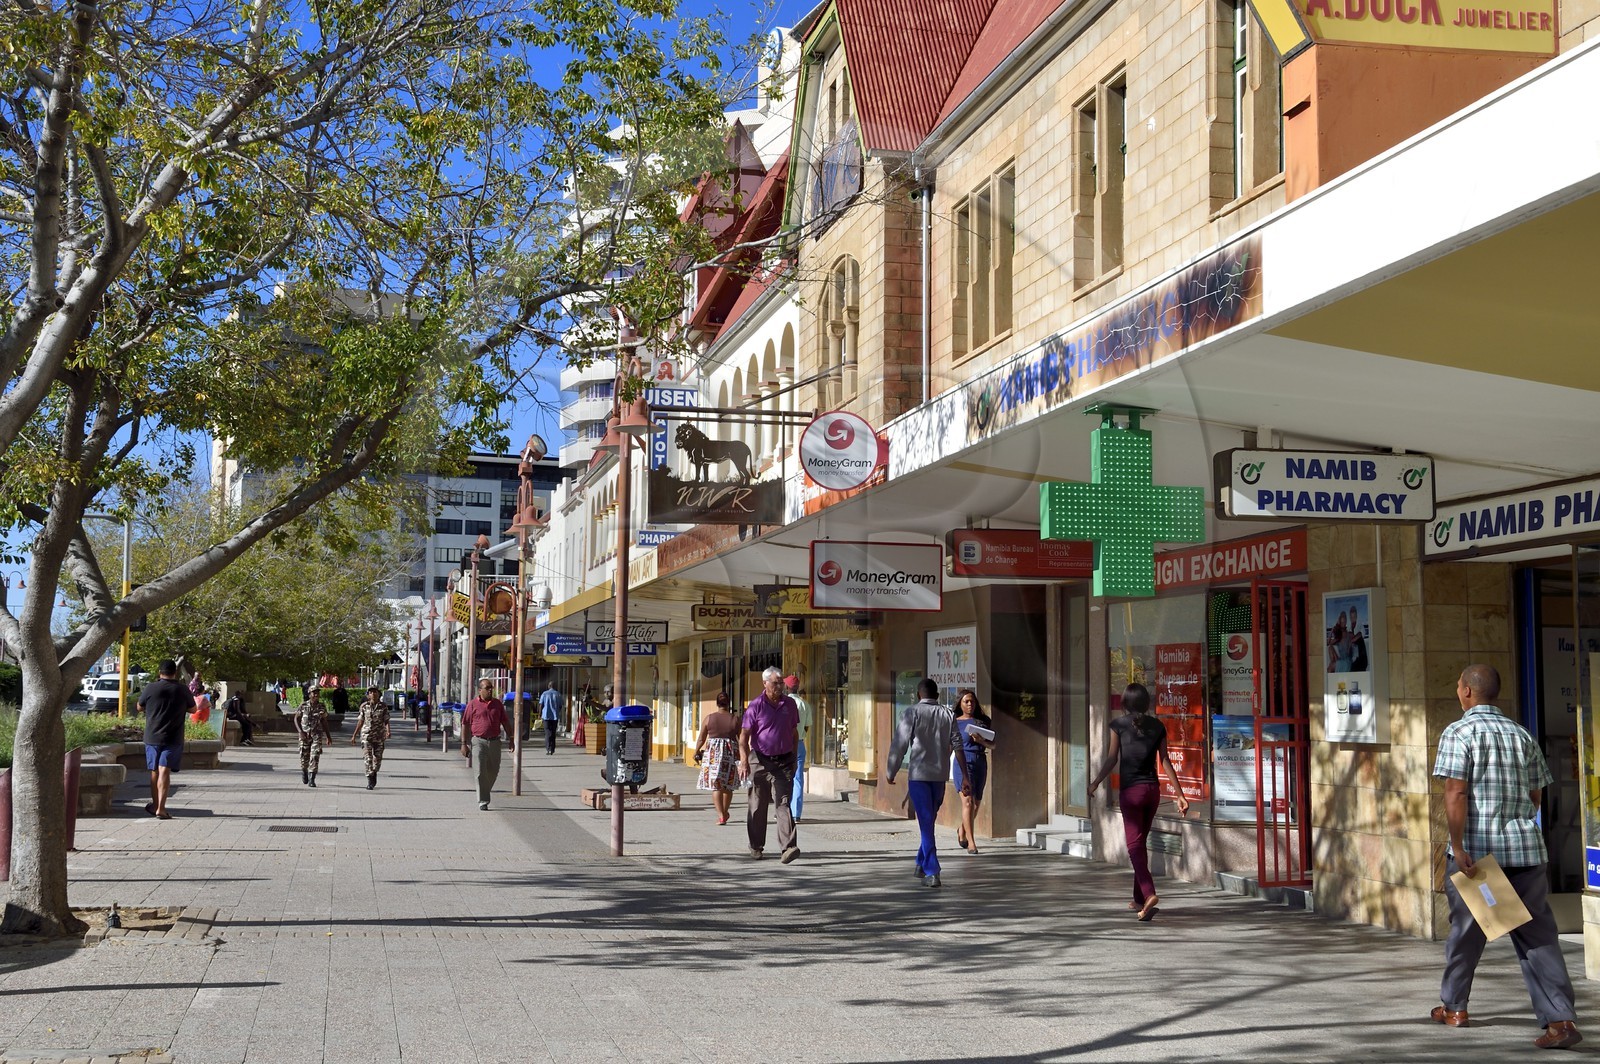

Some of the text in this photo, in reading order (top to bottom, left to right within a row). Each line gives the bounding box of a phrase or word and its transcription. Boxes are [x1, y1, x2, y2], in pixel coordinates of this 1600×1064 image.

[1453, 7, 1553, 31] JUWELIER
[808, 457, 872, 469] MoneyGram
[1285, 457, 1377, 481] NAMIB
[676, 485, 755, 512] NWR
[1257, 489, 1407, 514] PHARMACY
[1459, 499, 1544, 542] NAMIB
[985, 543, 1011, 553] Namibia
[1012, 545, 1034, 554] Bureau
[1040, 542, 1070, 550] Thomas
[1048, 549, 1069, 557] Cook
[1190, 538, 1292, 581] EXCHANGE
[985, 555, 1018, 565] de Change
[846, 569, 937, 586] MoneyGram
[846, 586, 910, 596] money transfer
[742, 619, 769, 629] ART
[953, 649, 968, 669] OFF
[1159, 650, 1190, 663] Namibia
[947, 673, 956, 683] PAY
[1158, 671, 1198, 685] Bureau de
[1158, 692, 1187, 710] Change
[1588, 861, 1595, 871] in
